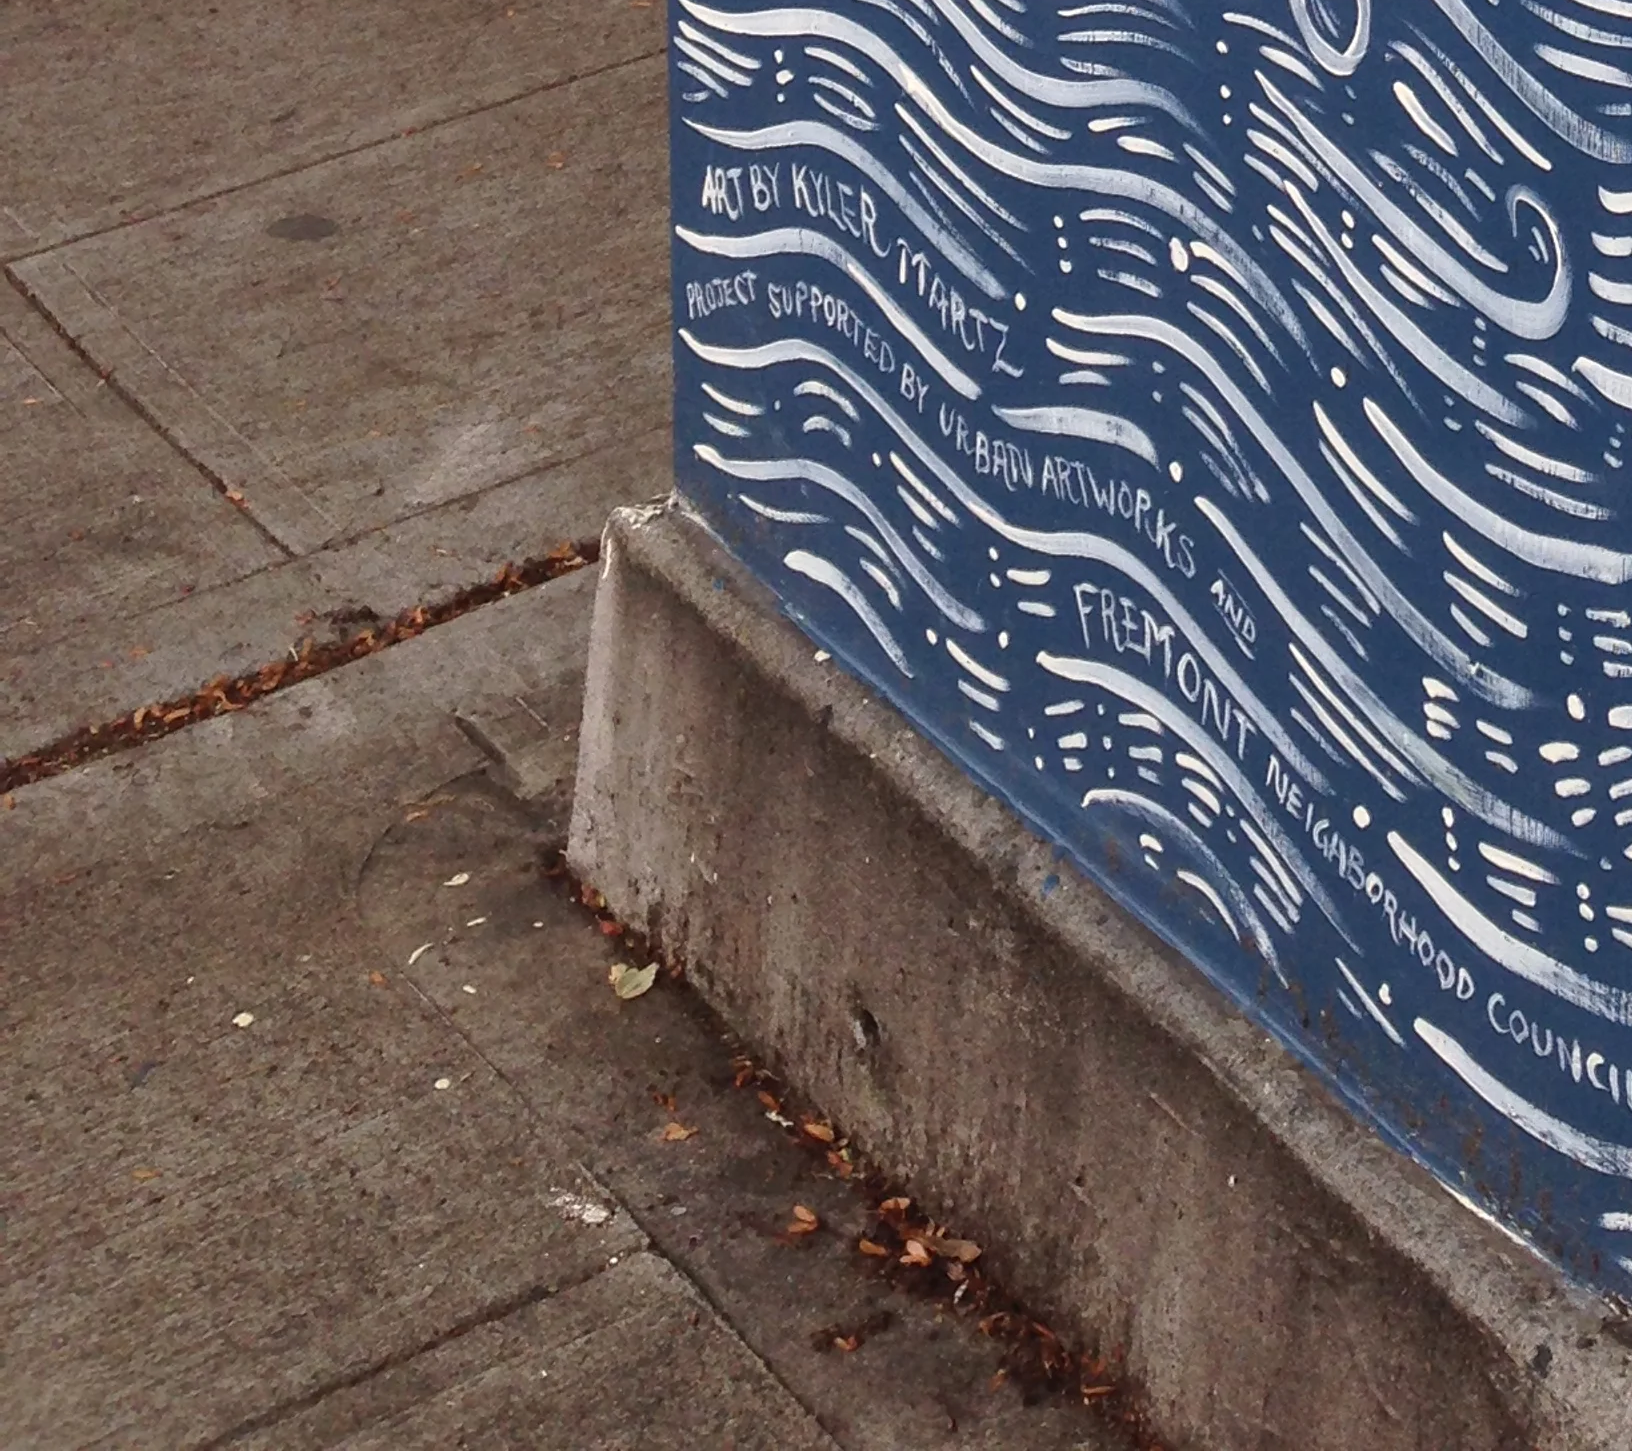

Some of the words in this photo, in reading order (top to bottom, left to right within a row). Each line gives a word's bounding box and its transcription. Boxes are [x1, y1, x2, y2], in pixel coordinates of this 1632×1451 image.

[702, 164, 743, 222] ART
[748, 161, 781, 212] BY
[791, 164, 891, 258] KYLER
[897, 237, 1024, 379] MARTZ
[686, 269, 757, 320] PROJECT
[767, 280, 895, 374] SUPPORTED
[900, 362, 929, 413] BY
[938, 402, 1034, 492] URBAN
[1041, 455, 1197, 580] ARTWORKS
[1210, 579, 1257, 643] AND
[1073, 582, 1258, 761] FREMONT
